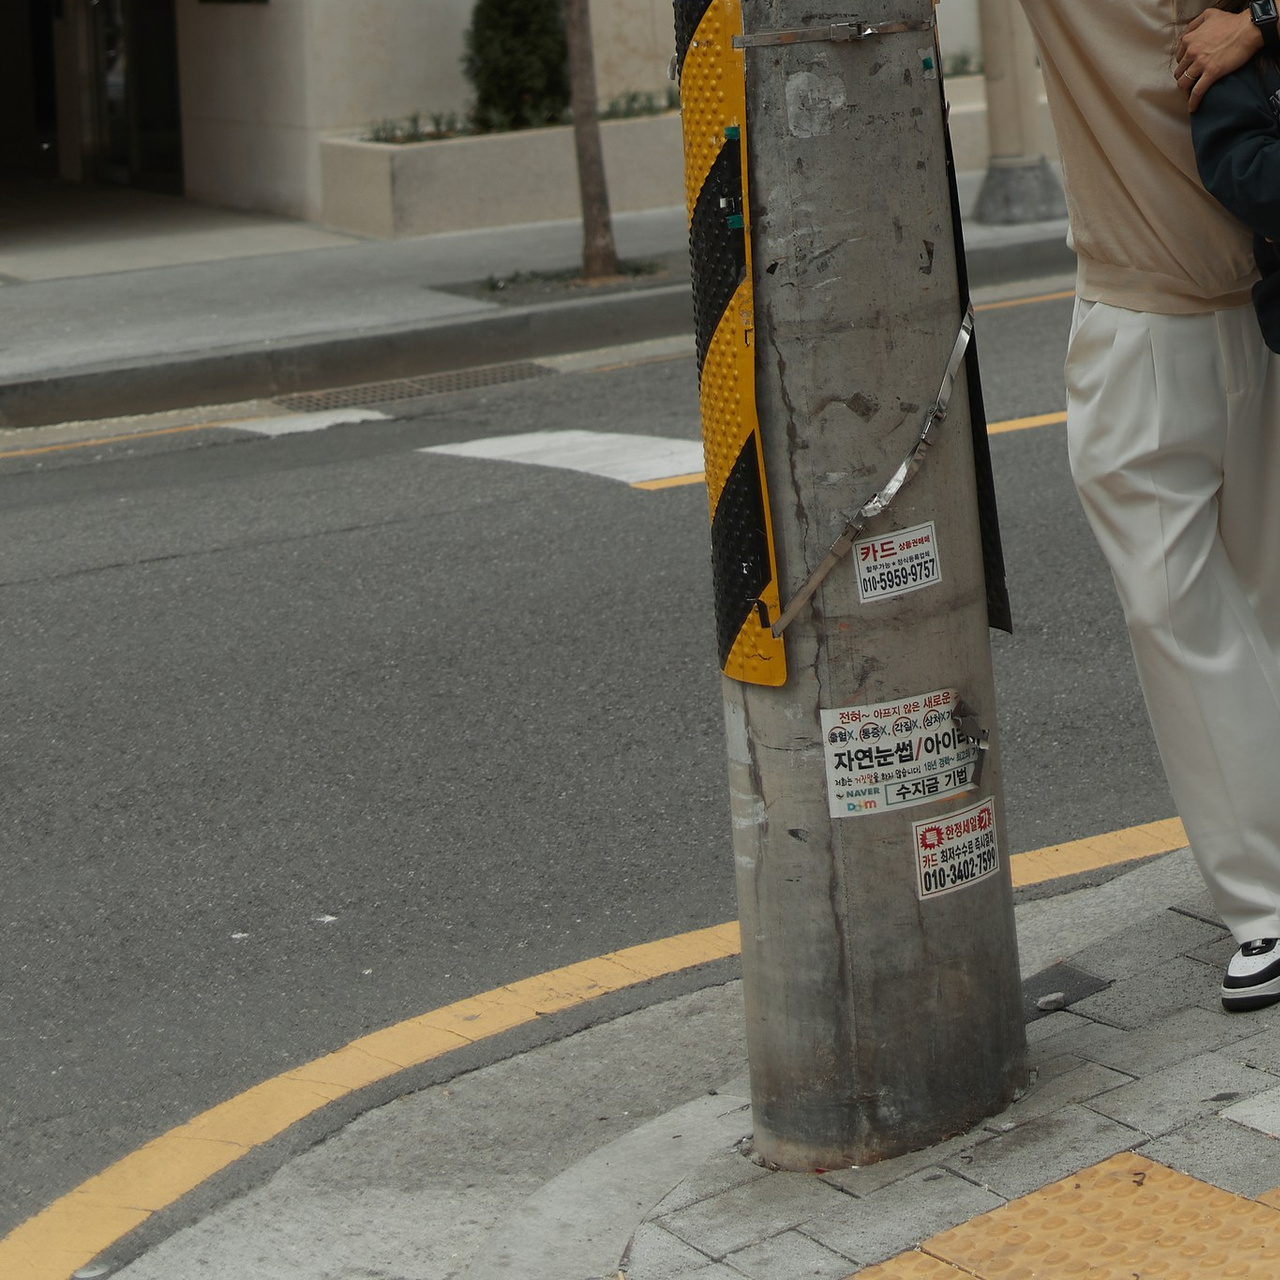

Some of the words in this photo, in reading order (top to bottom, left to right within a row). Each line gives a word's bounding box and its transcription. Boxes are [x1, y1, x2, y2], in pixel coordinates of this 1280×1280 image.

[861, 541, 897, 562] 카드
[863, 558, 935, 592] 010-5959-9757
[874, 706, 901, 719] 아프지
[903, 701, 920, 714] 않은
[923, 691, 951, 708] 새로운
[945, 767, 968, 787] 기법
[846, 788, 881, 798] NAVER
[945, 815, 977, 840] 한정세일
[922, 853, 938, 868] 카드
[941, 840, 974, 863] 최저수수료
[924, 847, 995, 891] 010-3402-7599
